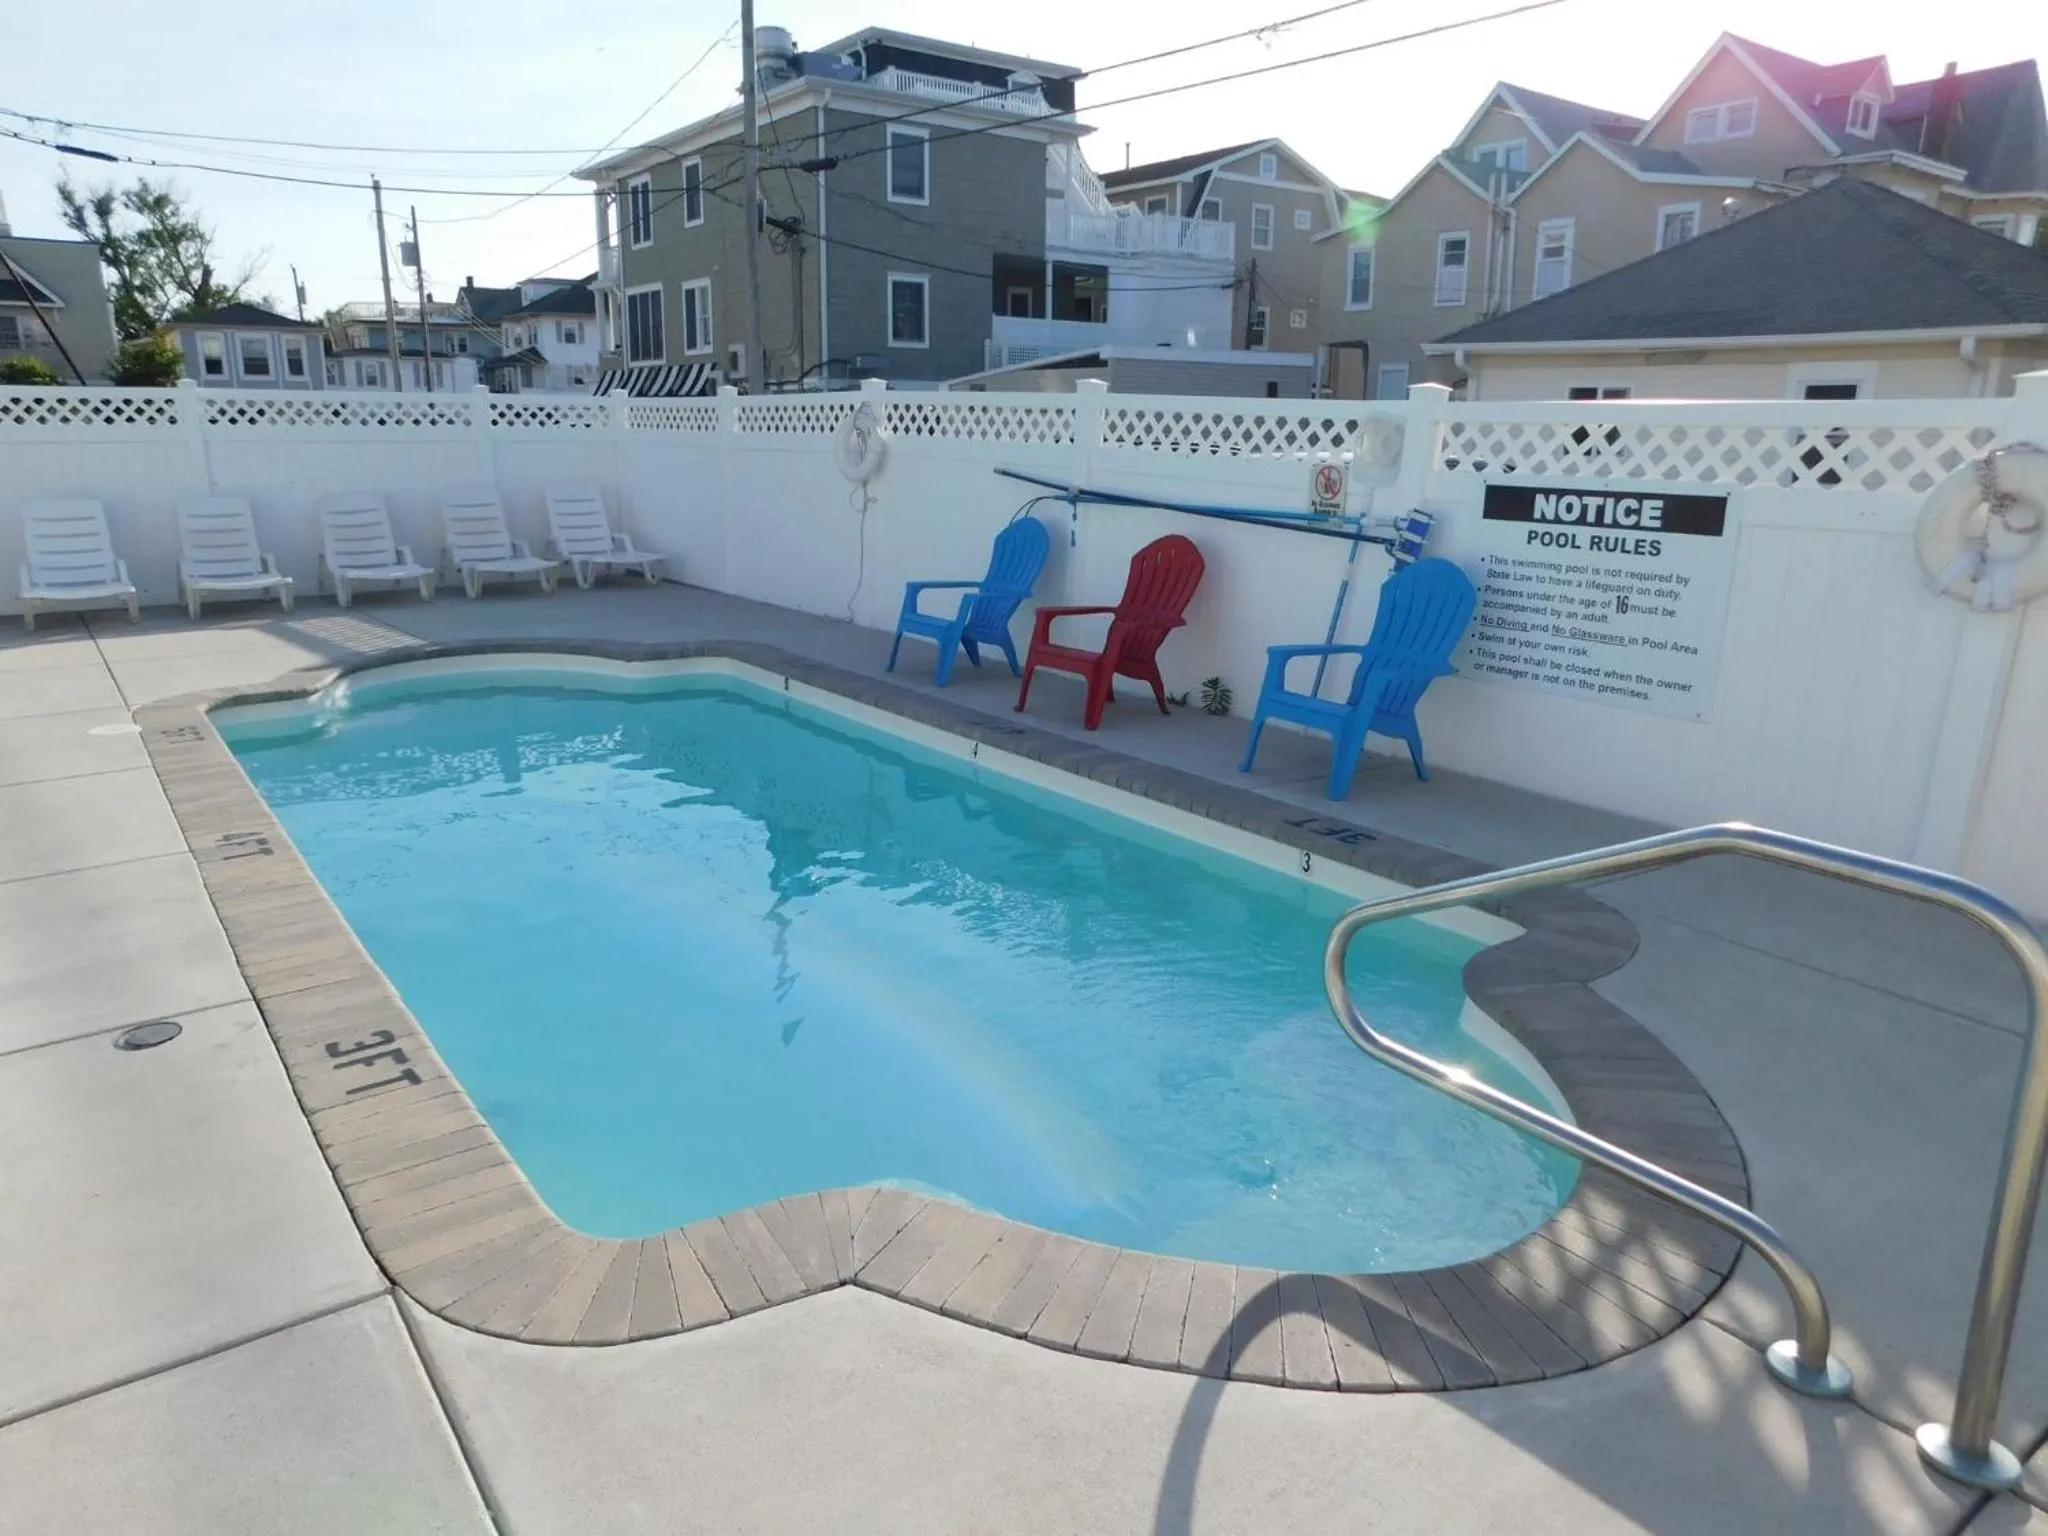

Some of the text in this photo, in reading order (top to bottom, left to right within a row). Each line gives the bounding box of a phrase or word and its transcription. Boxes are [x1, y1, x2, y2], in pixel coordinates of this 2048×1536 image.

[1532, 493, 1665, 528] NOTICE
[1527, 530, 1663, 557] POOL RULES
[1486, 568, 1511, 580] State
[1513, 571, 1533, 582] Law
[1536, 574, 1547, 583] to
[1549, 576, 1573, 586] have
[1576, 580, 1582, 588] a
[1586, 579, 1634, 594] lifeguard
[1636, 587, 1651, 596] on
[1489, 554, 1691, 588] This swimming pool is not required by
[1482, 599, 1548, 616] accompanied
[1550, 609, 1563, 619] by
[1565, 611, 1578, 620] an
[1484, 584, 1677, 618] Persons under the age of 16 must be
[1477, 631, 1504, 644] Swim
[1507, 636, 1517, 645] at
[1519, 638, 1541, 649] your
[1543, 643, 1566, 653] own
[1480, 614, 1699, 655] No Diving and No Glassware in Pool Area
[1474, 662, 1484, 670] or
[1486, 664, 1529, 680] manager
[1531, 672, 1540, 681] is
[1543, 673, 1560, 684] not
[1562, 678, 1576, 687] on
[1578, 679, 1596, 690] the
[1477, 647, 1694, 692] This pool shall be closed when the owner
[1302, 851, 1311, 873] 3
[325, 1029, 422, 1095] 3FT
